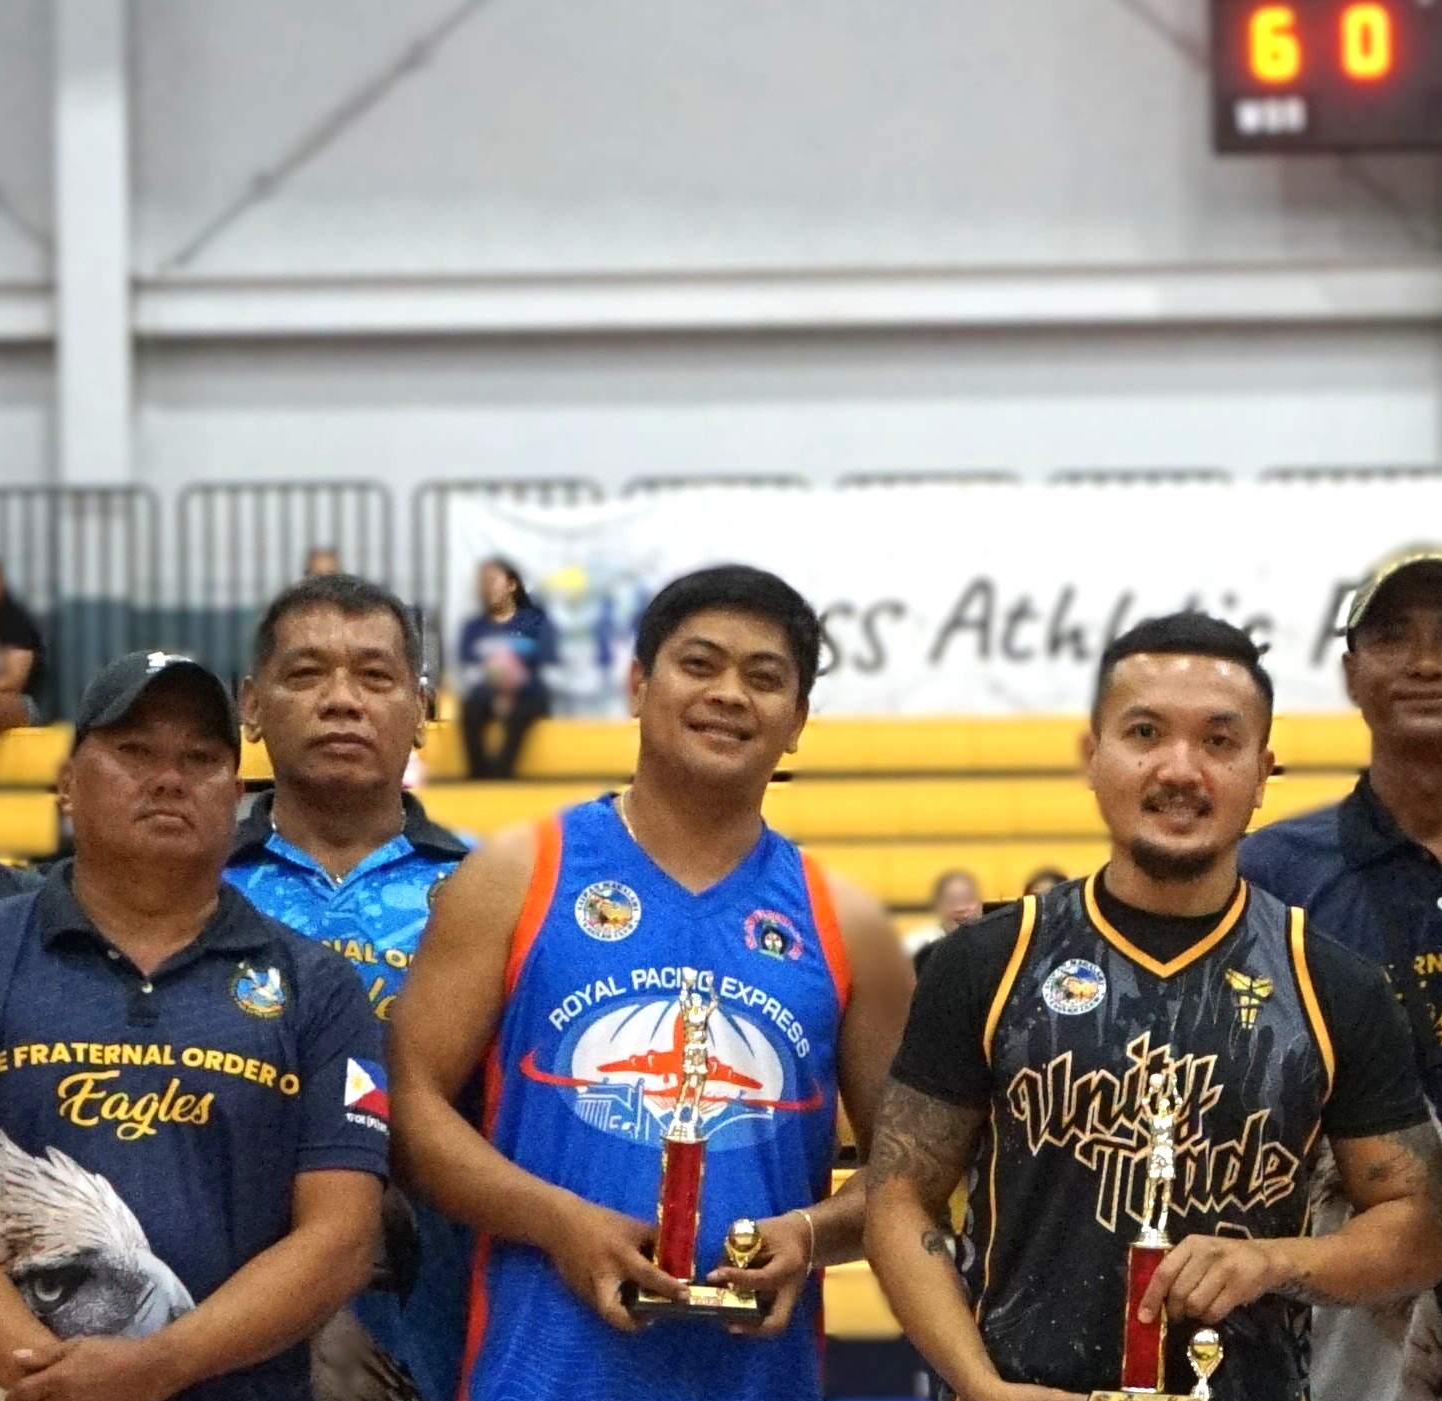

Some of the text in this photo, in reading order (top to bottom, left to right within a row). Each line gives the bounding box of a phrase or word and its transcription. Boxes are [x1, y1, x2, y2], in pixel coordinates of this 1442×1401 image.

[548, 967, 810, 1058] ROYAL PACIIC EXPRESS
[12, 1042, 176, 1068] FRATERNAL
[181, 1047, 279, 1088] ORDER
[57, 1069, 215, 1140] Eagles
[1006, 1030, 1225, 1156] Unity
